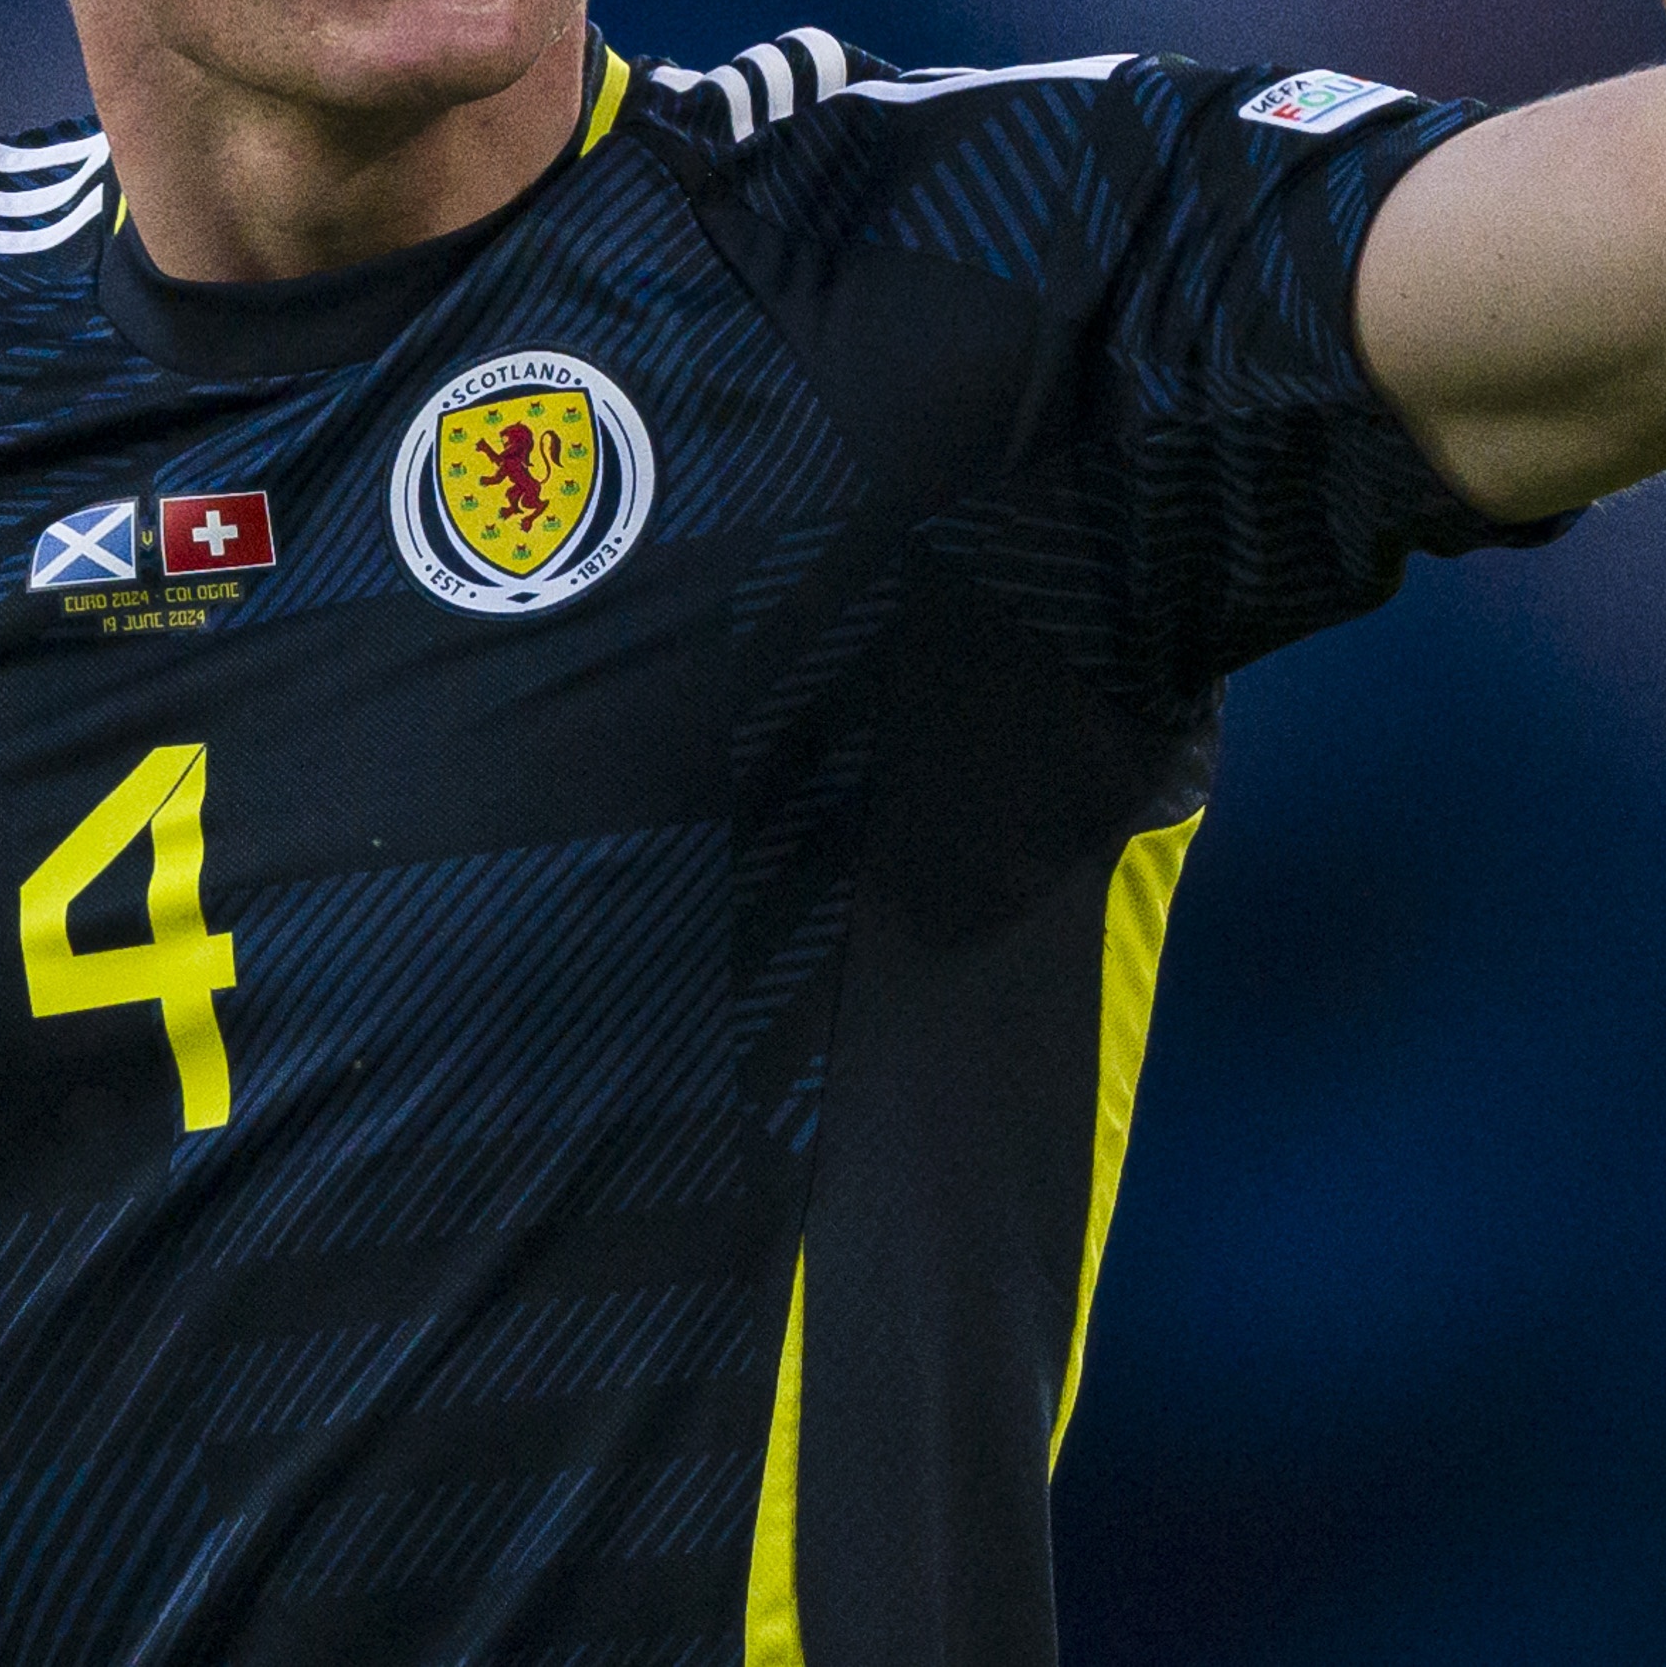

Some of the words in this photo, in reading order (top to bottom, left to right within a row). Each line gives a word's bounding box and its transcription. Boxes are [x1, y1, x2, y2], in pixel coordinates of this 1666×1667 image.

[451, 362, 572, 405] SCOTLAND
[576, 542, 619, 581] 1873
[64, 594, 108, 613] EURO
[111, 590, 150, 609] 2024
[164, 582, 241, 603] COLOGNE
[429, 568, 467, 597] EST
[102, 616, 117, 633] 19
[122, 611, 165, 632] JUNE
[167, 609, 207, 628] 2024
[19, 742, 237, 1132] 4
